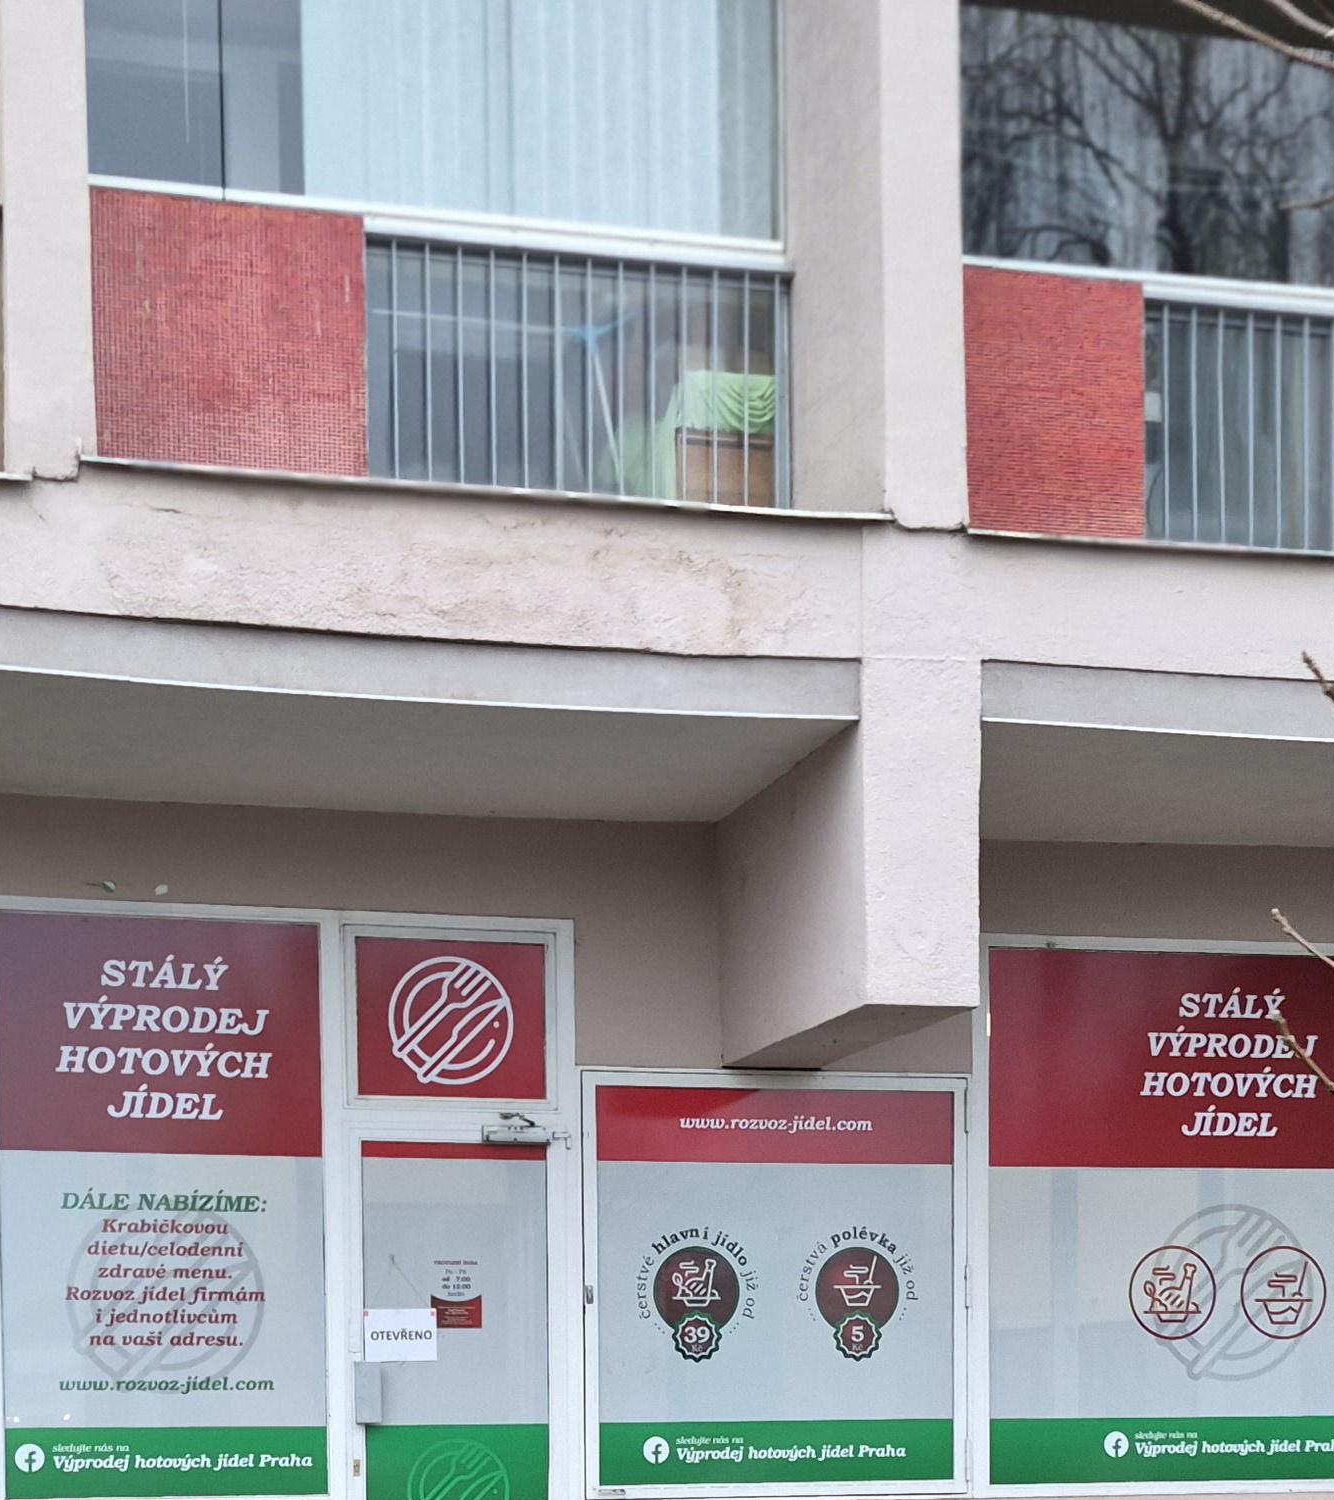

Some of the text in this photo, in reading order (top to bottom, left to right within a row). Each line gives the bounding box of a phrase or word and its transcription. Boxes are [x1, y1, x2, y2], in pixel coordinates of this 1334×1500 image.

[100, 954, 229, 990] STÁLÝ
[1179, 986, 1285, 1019] STÁLÝ
[63, 994, 270, 1035] VÝPRODEJ
[55, 1042, 272, 1078] HOTOVÝCH
[1140, 1066, 1319, 1098] HOTOVÝCH
[107, 1083, 224, 1120] JÍDEL
[679, 1115, 873, 1134] www.rozvoz-jídel.com
[1181, 1104, 1278, 1137] JÍDEL
[60, 1187, 267, 1213] DÁLE NABÍZÍME:
[101, 1218, 228, 1235] Krabičkovou
[87, 1240, 244, 1258] dietu/celodenní
[98, 1264, 233, 1279] zdravé menu.
[830, 1226, 898, 1255] polévka
[906, 1280, 919, 1301] od
[66, 1286, 266, 1305] Rozvoz jídel firmám
[95, 1308, 237, 1327] i jednotlivcům
[742, 1297, 755, 1319] od
[89, 1331, 244, 1346] na vaši adresu.
[370, 1328, 433, 1341] OTEVŘENO
[683, 1326, 710, 1344] 39
[850, 1325, 864, 1343] 5
[59, 1376, 275, 1394] www.rozvoz-jídel.com
[676, 1444, 907, 1463] Výprodej hotových jídel Praha
[1135, 1440, 1198, 1457] Výprodej
[1201, 1439, 1265, 1456] hotových
[52, 1453, 313, 1472] Výprodej hotových jídel Praha
